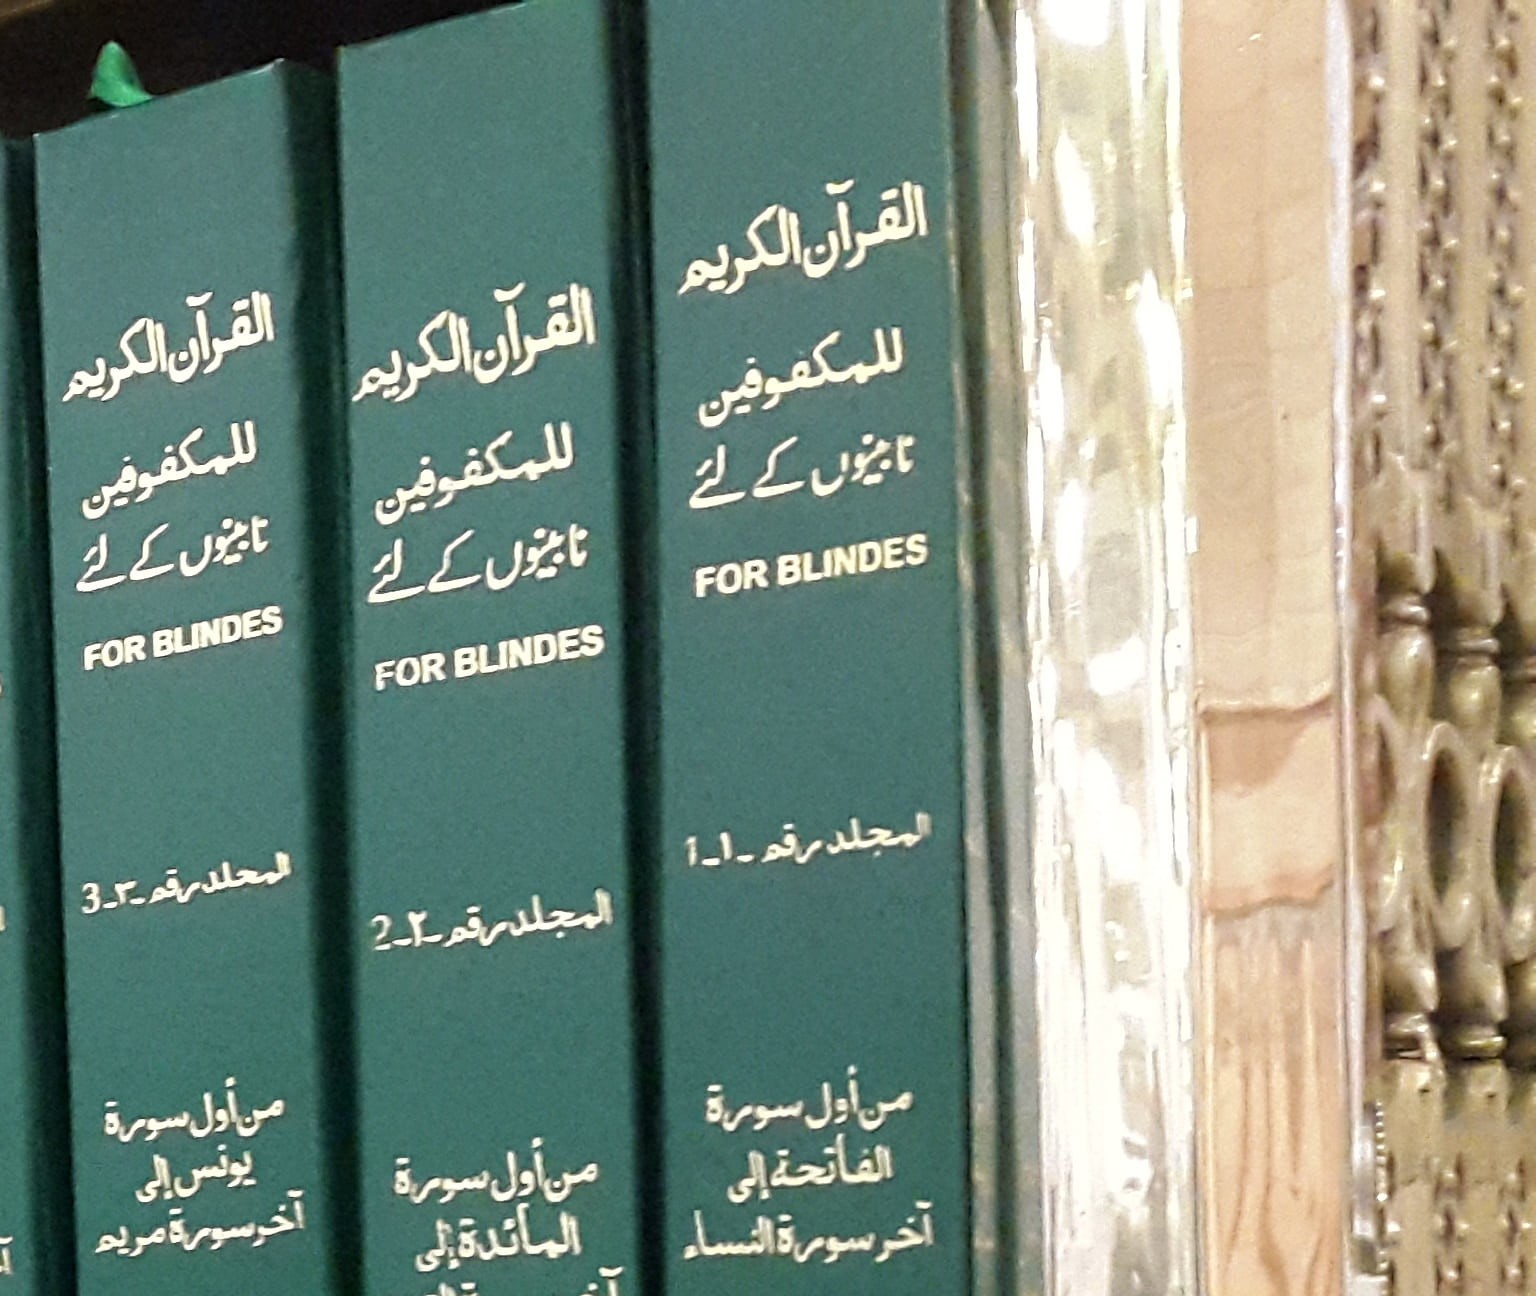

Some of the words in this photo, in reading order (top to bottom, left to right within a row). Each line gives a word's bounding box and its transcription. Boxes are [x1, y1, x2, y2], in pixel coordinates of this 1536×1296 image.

[677, 204, 803, 296] الكريم
[799, 179, 929, 279] القرآن
[61, 317, 169, 402] الكريم
[166, 290, 275, 383] القرآن
[351, 309, 474, 403] الكريم
[471, 282, 596, 384] القرآن
[698, 327, 904, 428] للمكفوفين
[81, 420, 260, 522] للمكفوفين
[374, 421, 576, 527] للمكفوفين
[695, 559, 769, 598] FOR
[776, 533, 929, 587] BLINDES
[83, 634, 147, 671] FOR
[152, 605, 284, 658] BLINDES
[374, 652, 447, 691] FOR
[453, 624, 605, 678] BLINDES
[104, 1101, 192, 1143] سورة
[187, 1076, 239, 1138] أول
[233, 1097, 285, 1137] من
[705, 1084, 804, 1132] سورة
[804, 1064, 862, 1130] أول
[856, 1091, 913, 1131] من
[393, 1157, 491, 1204] سورة
[490, 1136, 546, 1202] أول
[540, 1159, 599, 1203] من
[770, 1132, 893, 1187] الفاتحة
[94, 1225, 171, 1257] مريم
[251, 1189, 305, 1247] آخر
[873, 1200, 934, 1263] آخر
